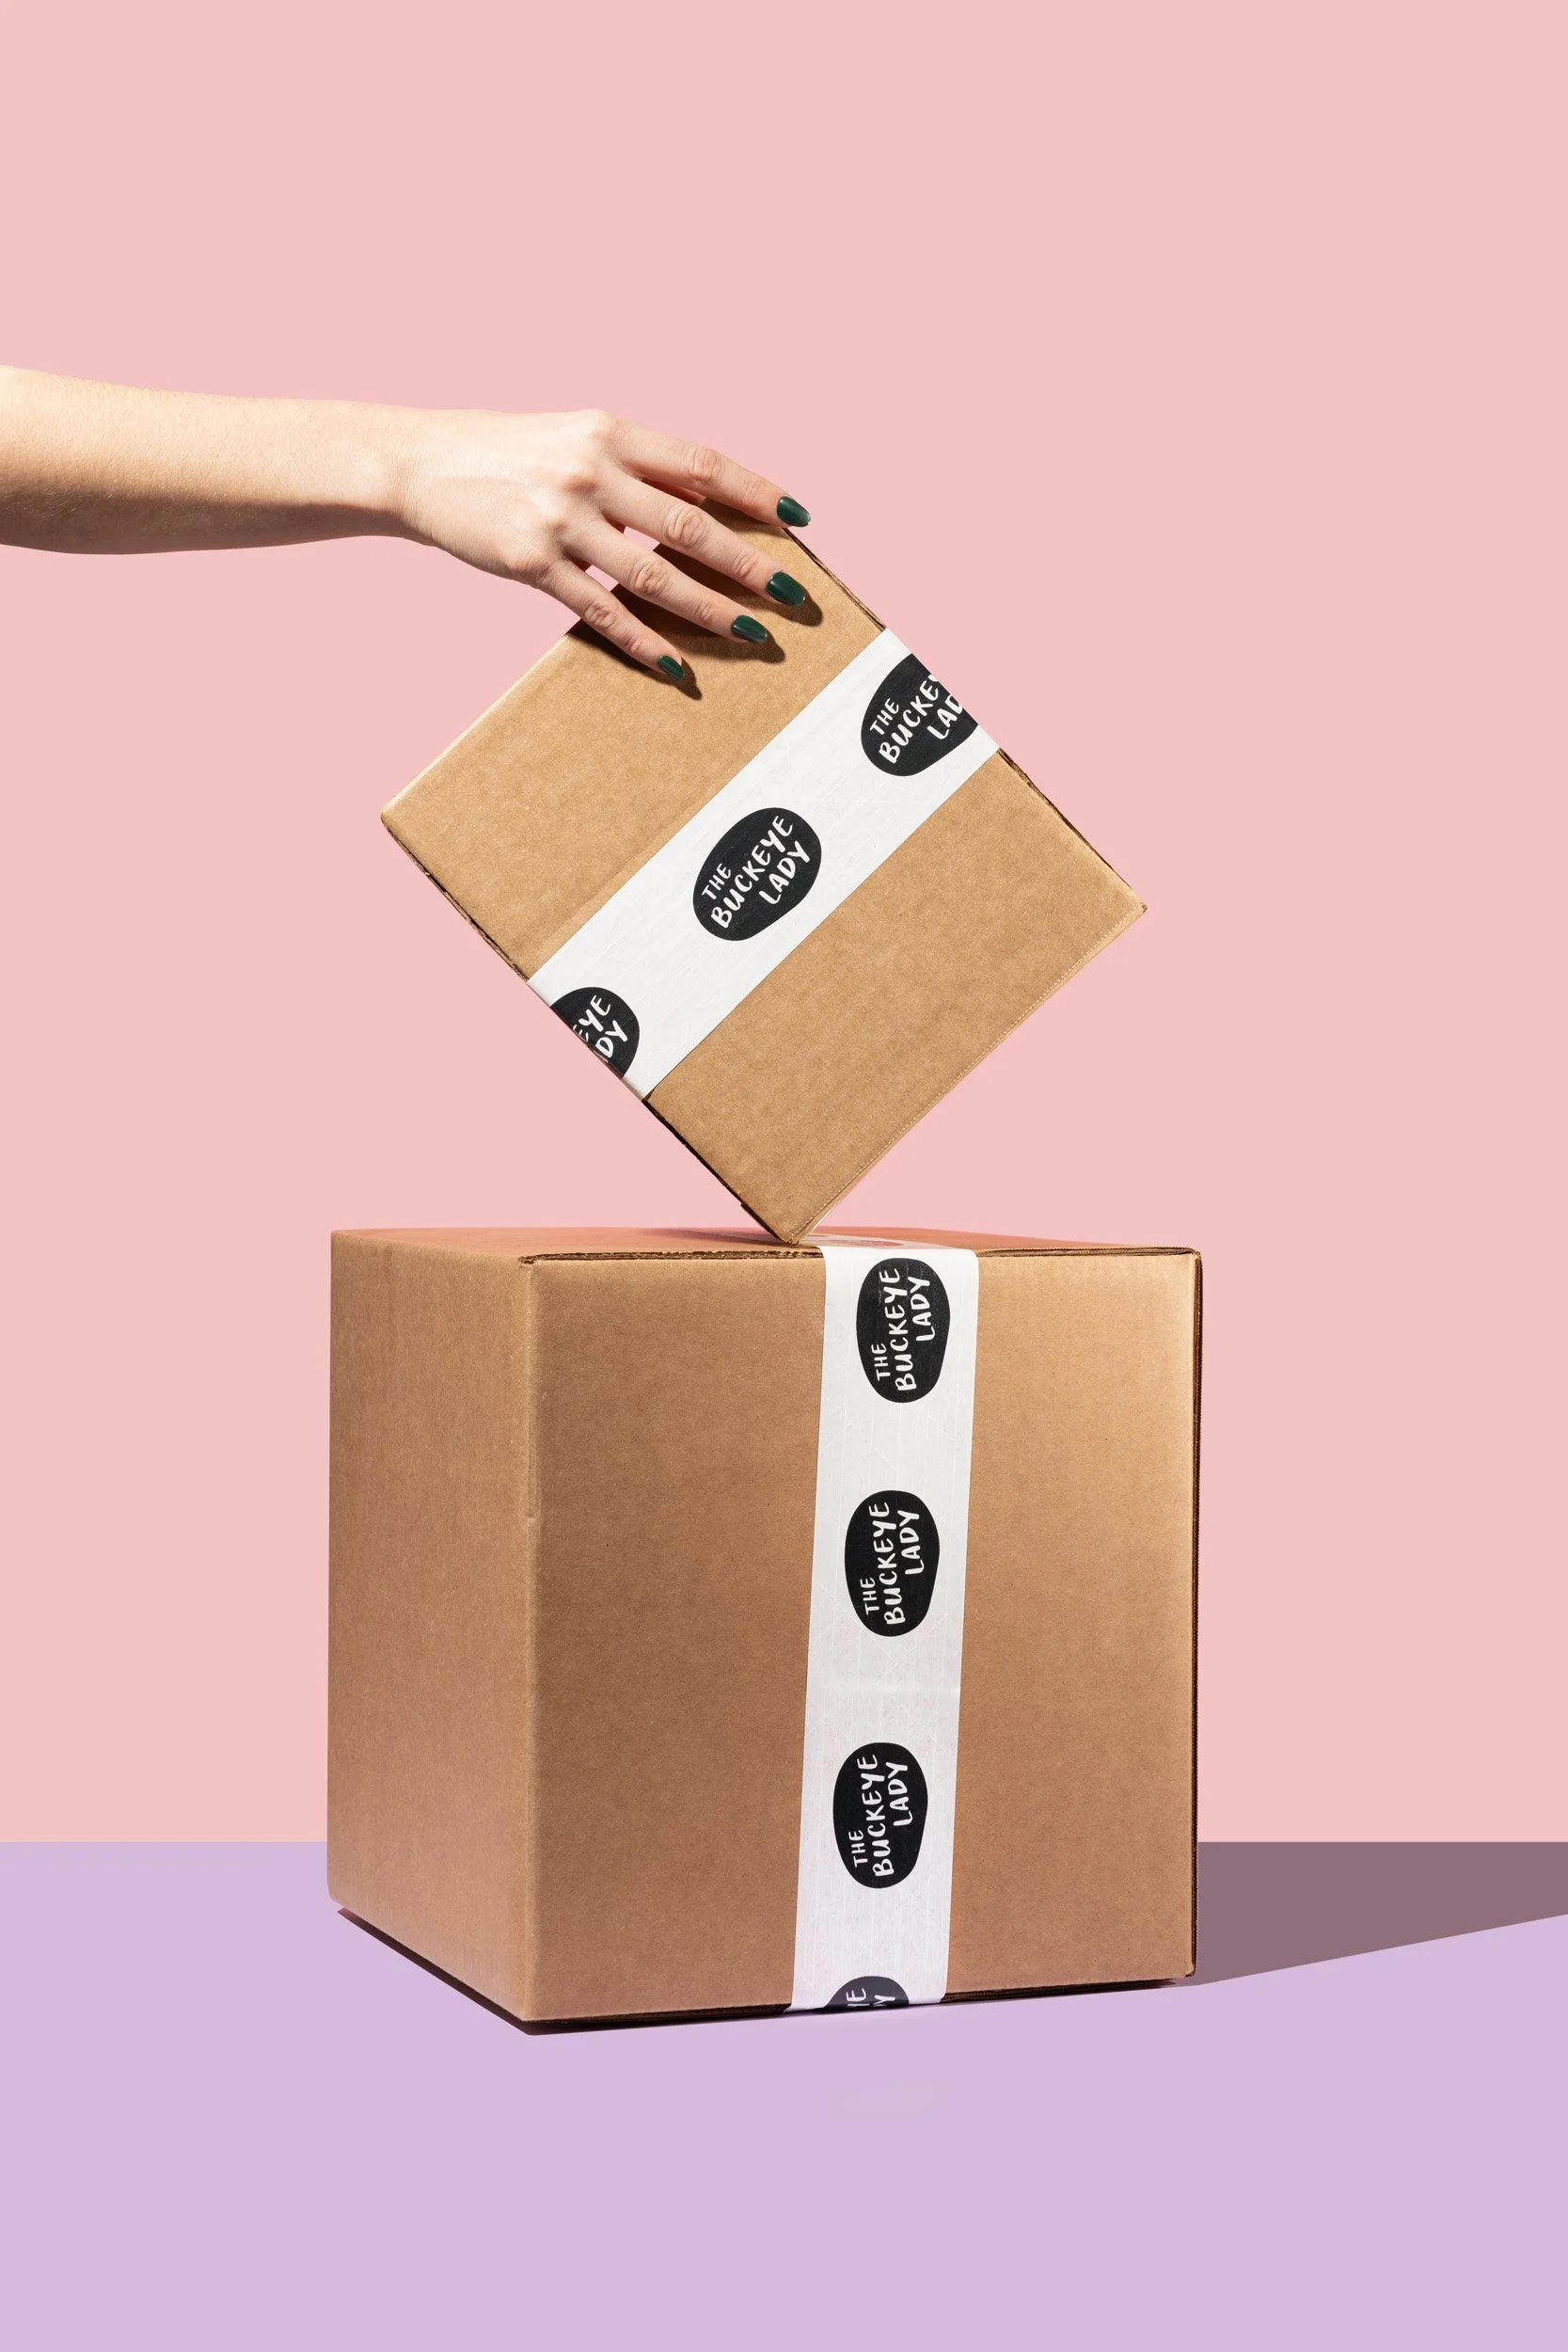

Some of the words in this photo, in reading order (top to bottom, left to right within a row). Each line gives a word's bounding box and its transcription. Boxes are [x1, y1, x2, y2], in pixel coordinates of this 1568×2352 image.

[869, 697, 899, 736] THE
[879, 674, 939, 764] BUCKE
[701, 863, 732, 900] THE
[710, 815, 793, 929] BUCKEYE
[758, 840, 811, 905] LADY
[879, 1267, 917, 1391] BUCKEYE
[907, 1276, 936, 1342] LADY
[871, 1343, 891, 1382] THE
[868, 1502, 906, 1625] BUCKEYE
[896, 1510, 925, 1575] LADY
[860, 1577, 880, 1615] THE
[856, 1754, 895, 1877] BUCKEYE
[885, 1761, 913, 1827] LADY
[847, 1829, 868, 1868] THE
